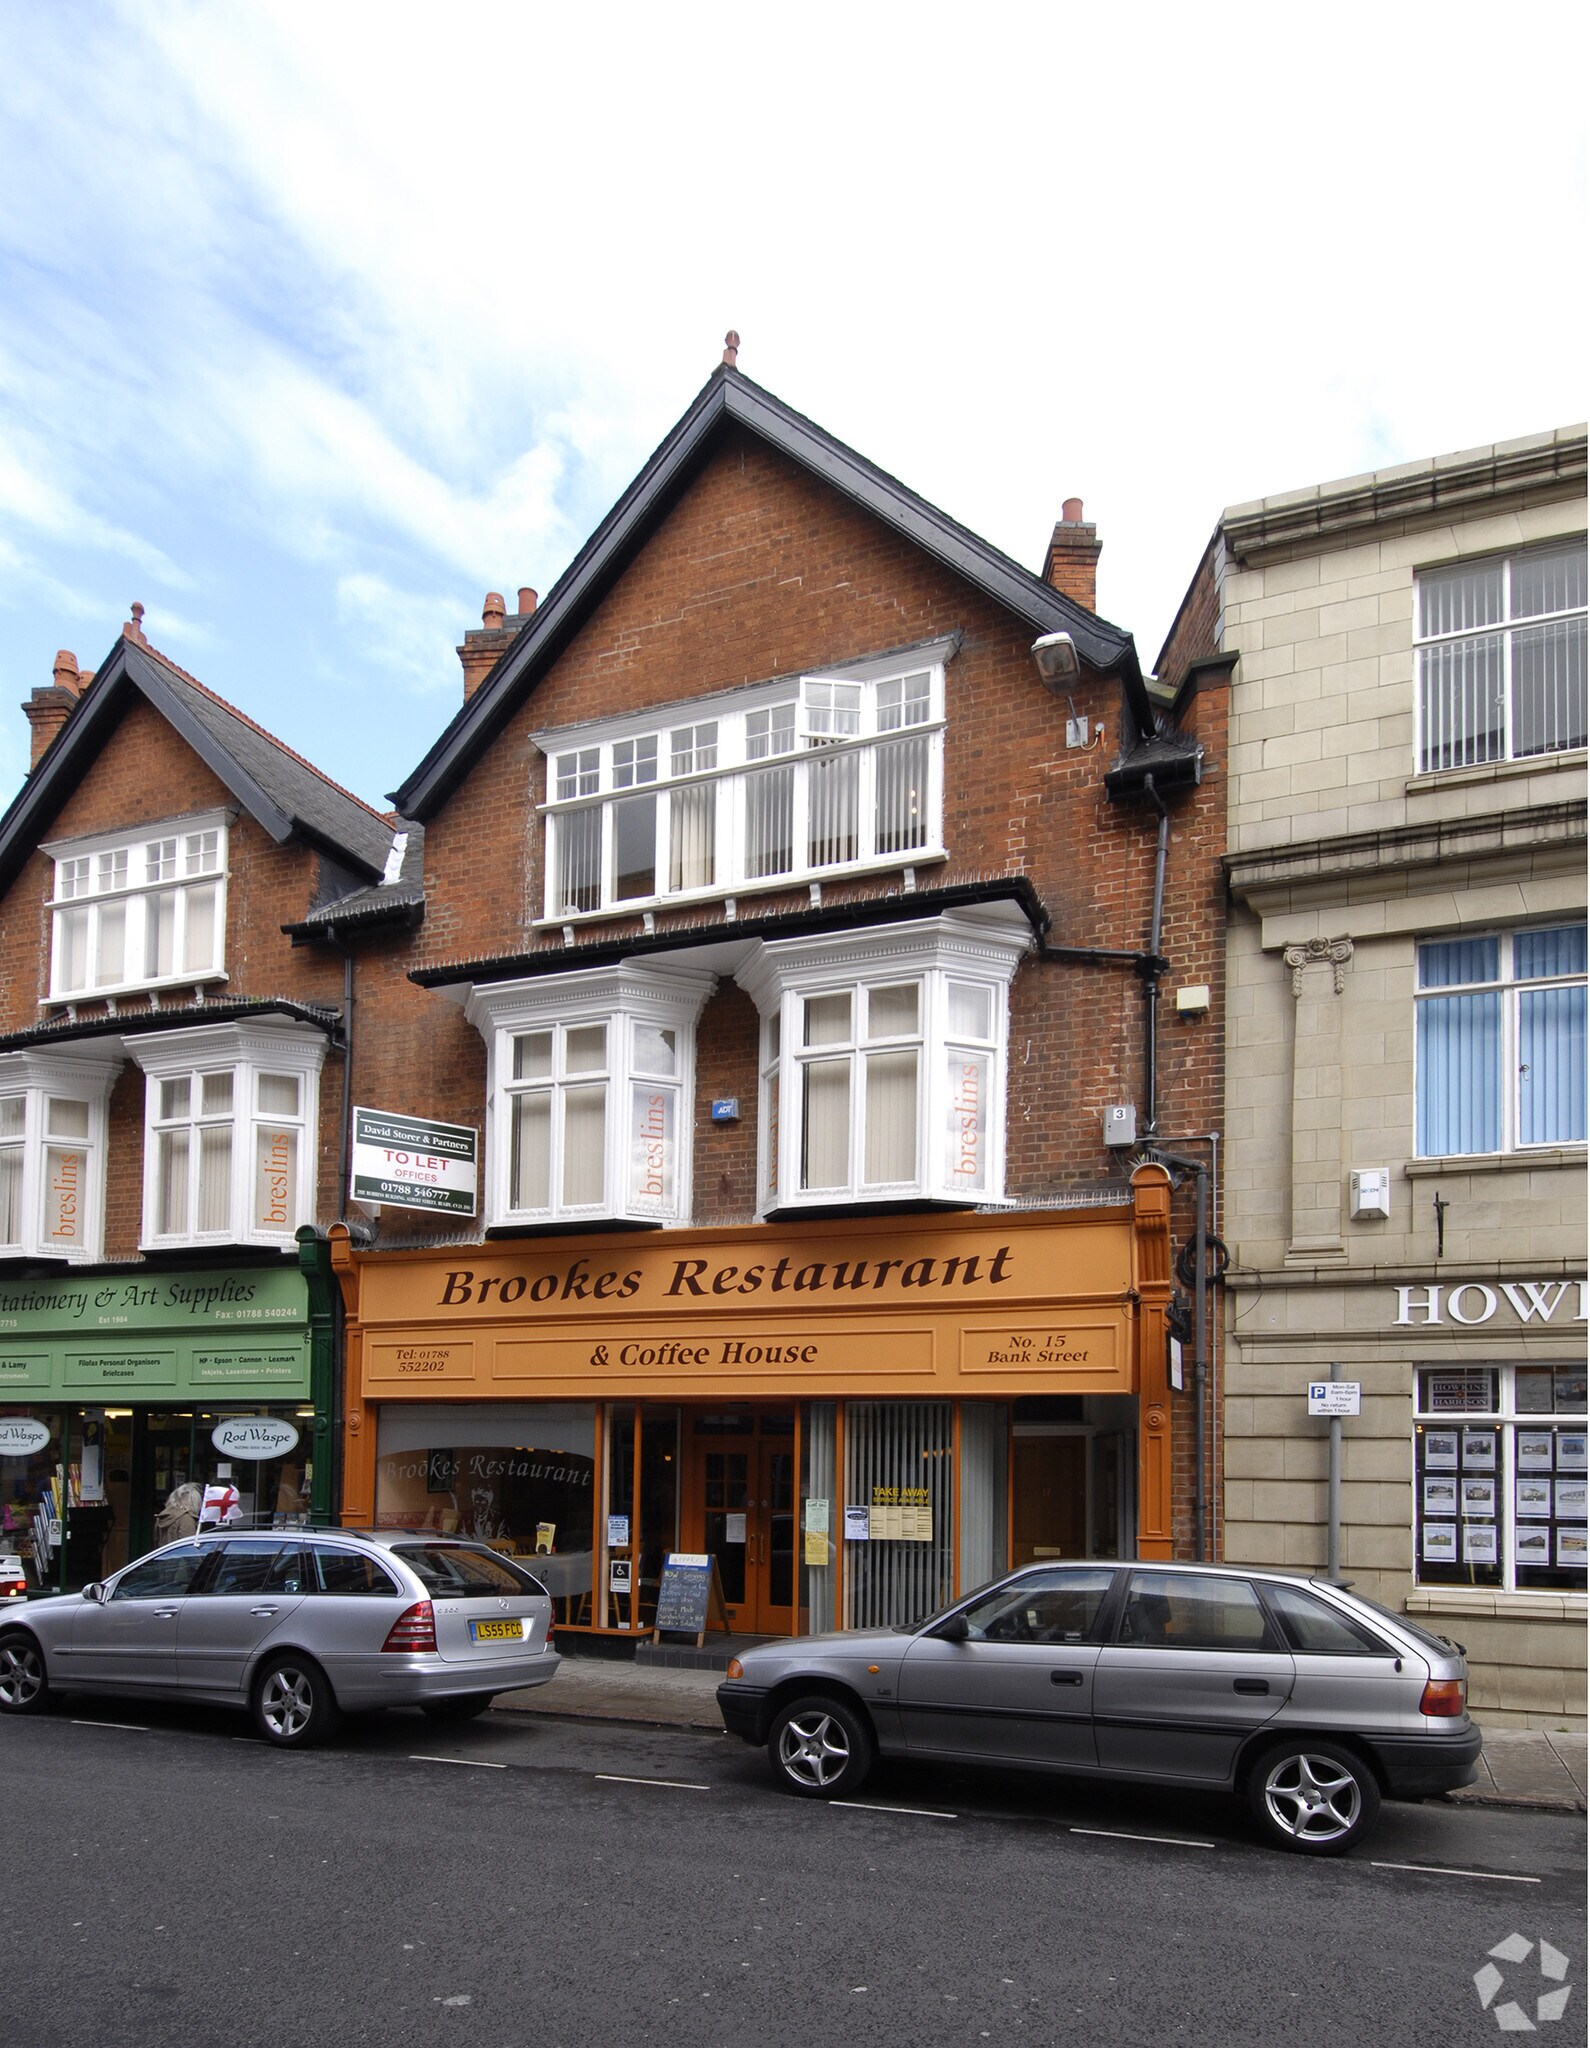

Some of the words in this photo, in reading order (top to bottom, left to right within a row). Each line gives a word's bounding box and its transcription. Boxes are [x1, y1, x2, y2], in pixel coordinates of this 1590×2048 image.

[718, 1105, 732, 1114] ADT
[1116, 1109, 1124, 1118] 3
[953, 1064, 978, 1175] breslins
[364, 1125, 391, 1137] David
[393, 1130, 421, 1142] Storer
[422, 1135, 430, 1144] &
[433, 1137, 469, 1150] Partners
[639, 1095, 665, 1195] breslins
[383, 1150, 409, 1164] TO
[416, 1156, 450, 1171] LET
[263, 1133, 289, 1223] breslins
[394, 1169, 438, 1183] OFFICES
[53, 1154, 78, 1237] breslins
[381, 1182, 411, 1195] 01788
[414, 1188, 450, 1201] 546777
[437, 1259, 643, 1306] Brookes
[662, 1246, 1014, 1297] Restaurant
[0, 1290, 88, 1318] tationery
[95, 1287, 118, 1308] &
[120, 1285, 159, 1307] Art
[164, 1277, 256, 1314] Supplies
[215, 1310, 234, 1319] Fax:
[236, 1309, 262, 1319] 01788
[265, 1308, 298, 1318] 540244
[1009, 1336, 1036, 1348] No.
[1045, 1334, 1067, 1348] 15
[214, 1357, 233, 1365] Epson
[268, 1355, 295, 1363] Lexmark
[396, 1349, 417, 1360] Tel:
[420, 1350, 449, 1359] 01788
[590, 1344, 609, 1366] &
[620, 1342, 710, 1366] Coffee
[718, 1341, 818, 1364] House
[987, 1351, 1031, 1363] Bank
[1037, 1350, 1089, 1362] Street
[8, 1362, 27, 1370] Lamy
[78, 1359, 98, 1367] Filofax
[99, 1359, 126, 1367] Personal
[127, 1358, 161, 1367] Organisers
[398, 1361, 445, 1372] 552202
[1434, 1384, 1488, 1392] HOWKINS
[1433, 1398, 1487, 1406] HARRISON
[10, 1427, 44, 1445] Waspe
[222, 1431, 247, 1445] Rod
[249, 1428, 291, 1447] Waspe
[386, 1454, 461, 1481] Brookes
[469, 1455, 592, 1487] Restaurant
[873, 1487, 900, 1497] TAKE
[901, 1488, 929, 1497] AWAY
[478, 1623, 504, 1638] LS55
